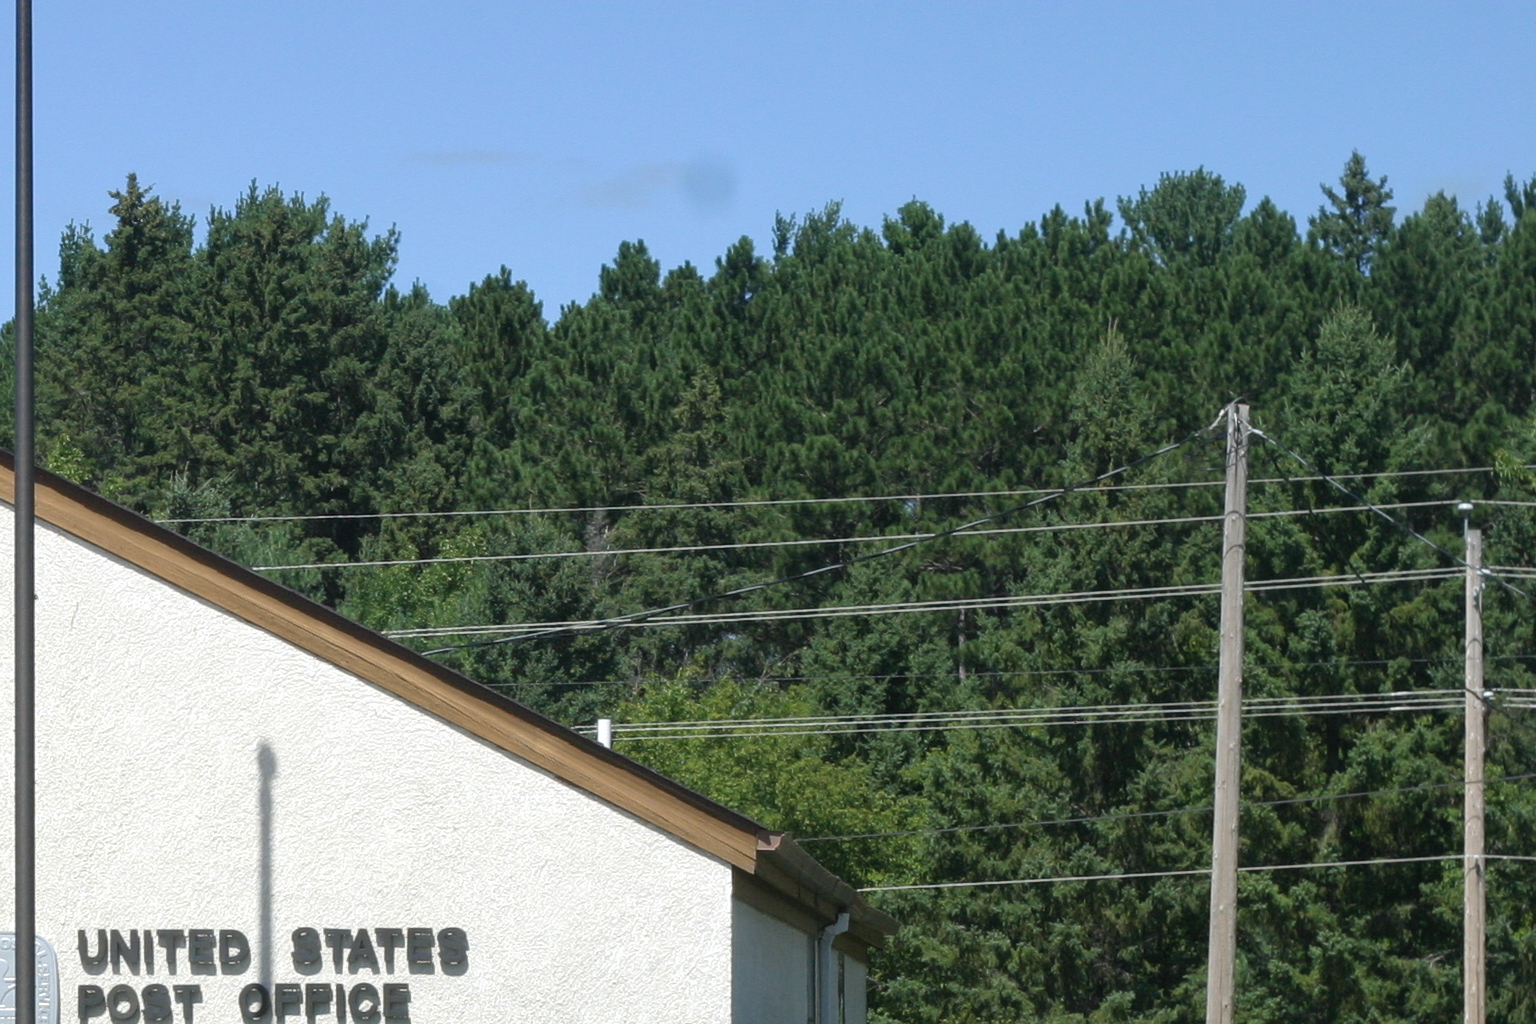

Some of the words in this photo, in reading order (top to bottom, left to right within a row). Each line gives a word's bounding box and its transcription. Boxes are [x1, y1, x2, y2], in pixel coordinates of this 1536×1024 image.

[77, 929, 251, 968] UNITED
[291, 927, 469, 967] STATES
[77, 984, 202, 1023] POST
[239, 983, 410, 1022] OFFICE
